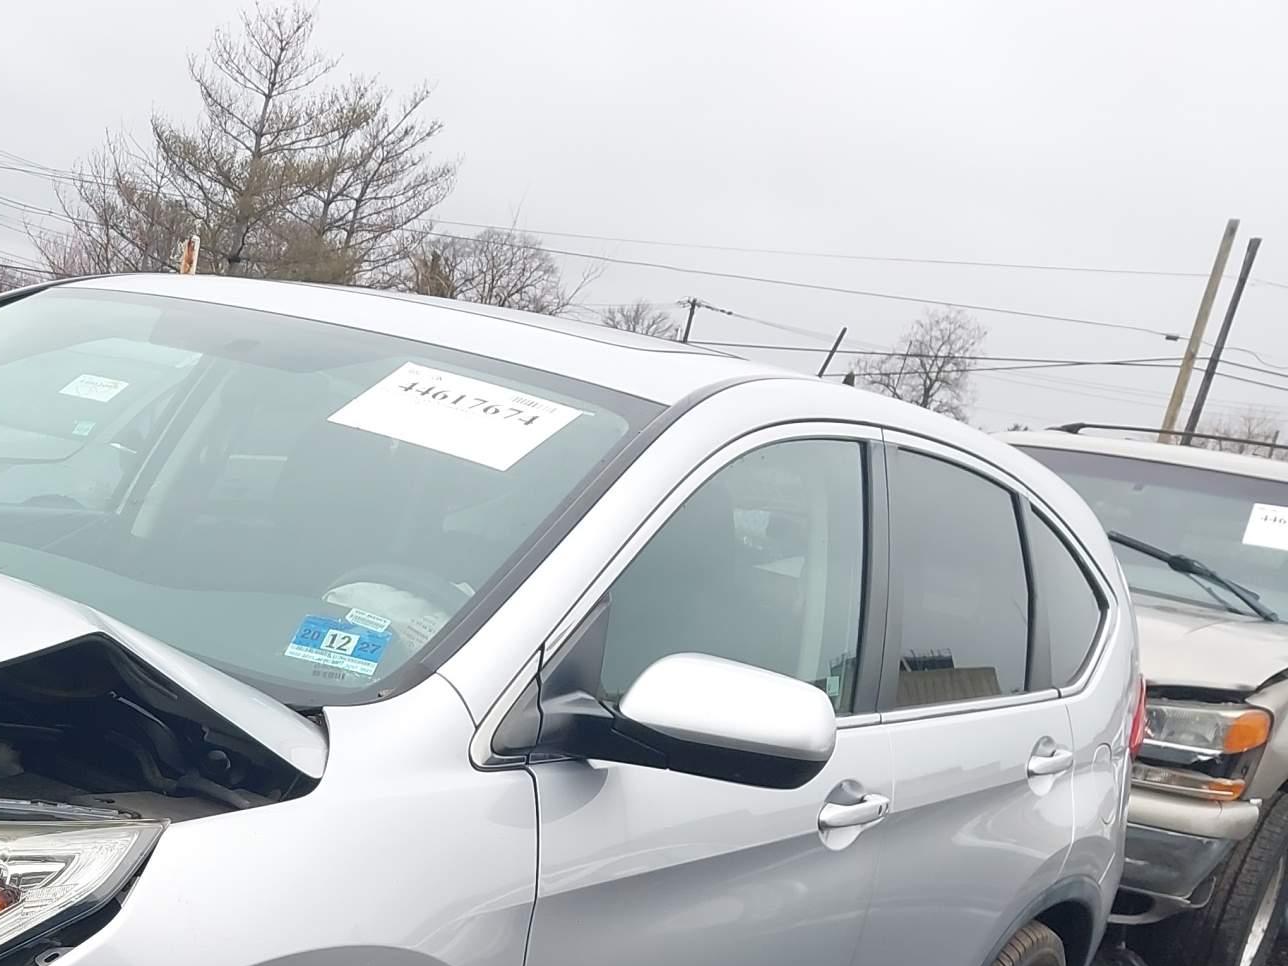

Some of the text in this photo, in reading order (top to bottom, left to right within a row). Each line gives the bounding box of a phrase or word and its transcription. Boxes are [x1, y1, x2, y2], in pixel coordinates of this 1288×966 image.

[398, 381, 540, 426] 44617674
[300, 628, 381, 654] 20 12 27
